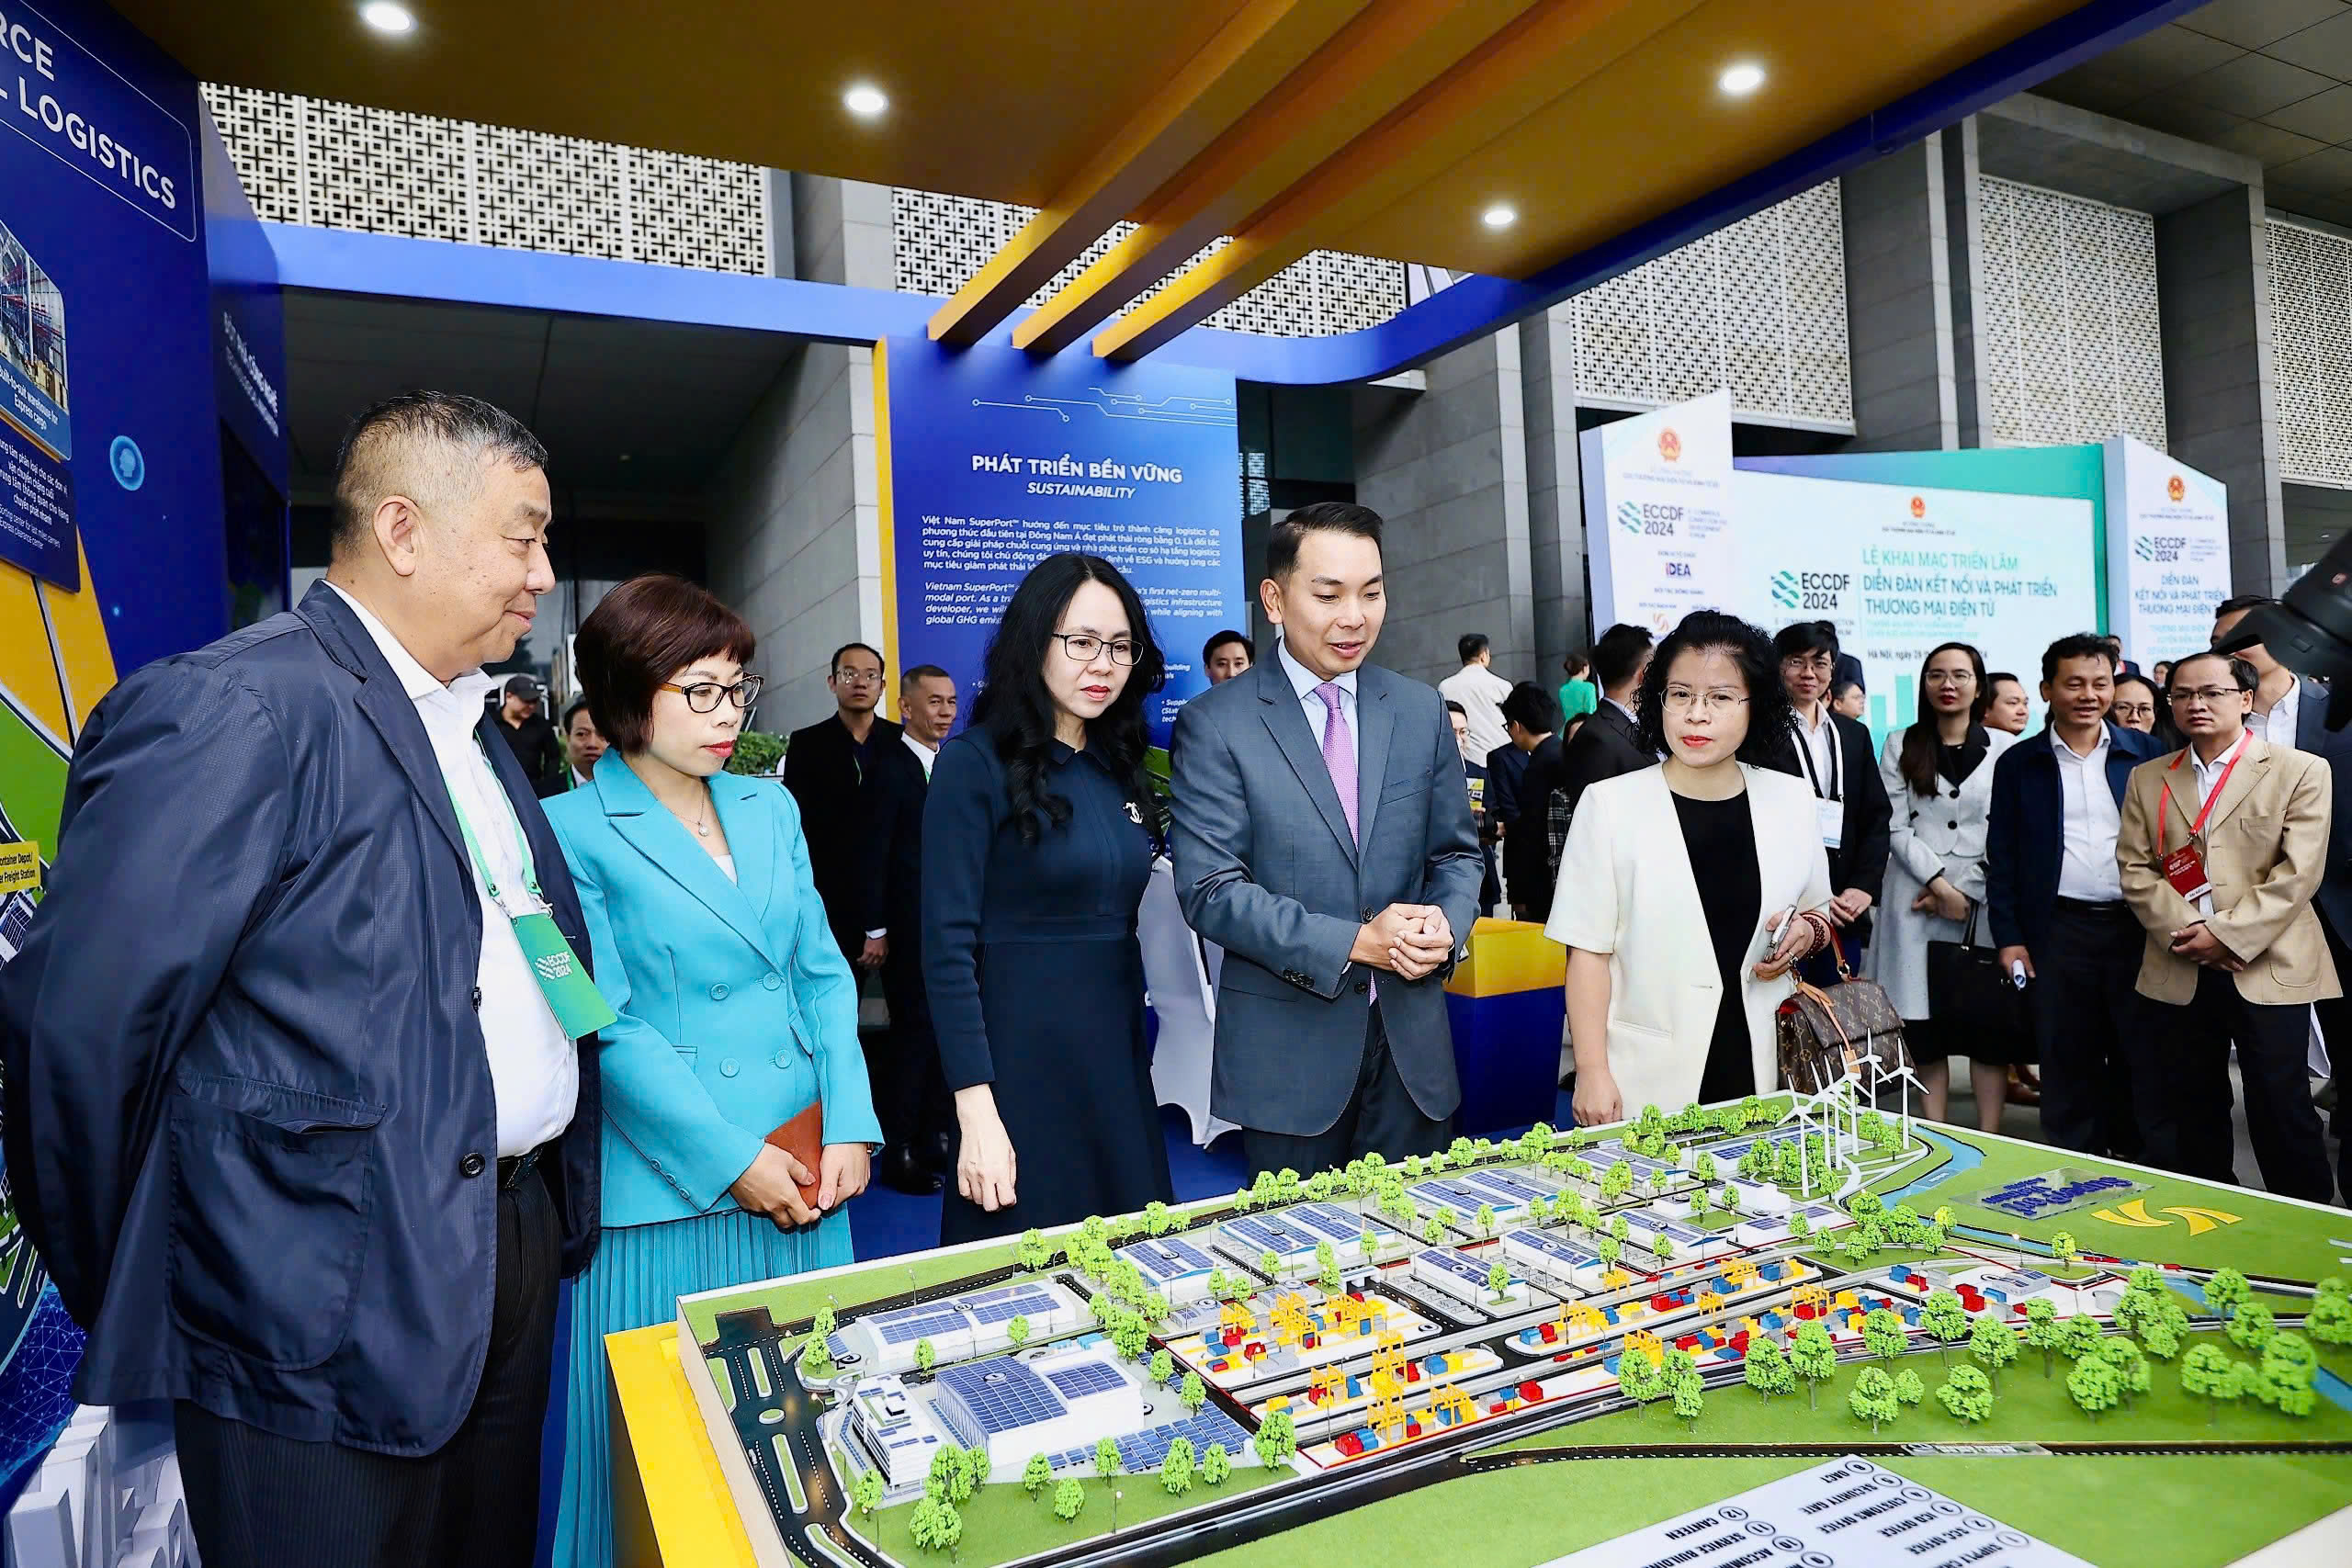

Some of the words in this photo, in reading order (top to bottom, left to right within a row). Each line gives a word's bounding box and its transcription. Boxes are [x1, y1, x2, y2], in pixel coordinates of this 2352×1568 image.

[18, 76, 176, 209] LOGISTICS
[971, 453, 1023, 474] PHÁT
[1027, 453, 1084, 478] TRIỂN
[1089, 458, 1126, 479] BỀN
[1130, 462, 1183, 484] VỮNG
[1026, 481, 1136, 500] SUSTAINABILITY
[922, 515, 941, 526] Việt
[944, 516, 966, 525] Nam
[1643, 503, 1684, 521] ECCDF
[1053, 532, 1073, 540] Nam
[1645, 520, 1675, 536] 2024
[922, 539, 946, 548] cung
[1030, 542, 1052, 552] cung
[2154, 536, 2187, 549] ECCDF
[1136, 555, 1153, 564] ESG
[1883, 549, 1915, 567] KHAI
[2154, 550, 2178, 562] 2024
[924, 581, 962, 591] Vietnam
[1165, 588, 1198, 597] net-zero
[1801, 572, 1850, 592] ECCDF
[924, 592, 954, 603] modal
[955, 594, 978, 604] port.
[978, 594, 991, 603] As
[1144, 598, 1170, 607] gistics
[1170, 598, 1223, 607] infrastructure
[1803, 592, 1838, 610] 2024
[925, 604, 973, 615] developer,
[975, 605, 989, 614] we
[1150, 608, 1172, 616] while
[1172, 608, 1204, 618] aligning
[1206, 608, 1224, 617] with
[925, 615, 956, 626] global
[956, 615, 978, 625] GHG
[546, 951, 571, 965] ECCDF
[553, 964, 573, 979] 2024
[1830, 1483, 1878, 1506] SECURITY
[1798, 1500, 1829, 1516] GATE
[1853, 1496, 1907, 1521] CUSTOMS
[1816, 1514, 1859, 1535] OFFICE
[1914, 1511, 1939, 1524] ICD
[1664, 1517, 1720, 1540] CANTEEN
[1876, 1519, 1918, 1538] OFFICE
[1696, 1531, 1747, 1554] SERVICE
[1905, 1535, 1948, 1555] OFFICE
[1958, 1542, 2004, 1564] SUPPLY
